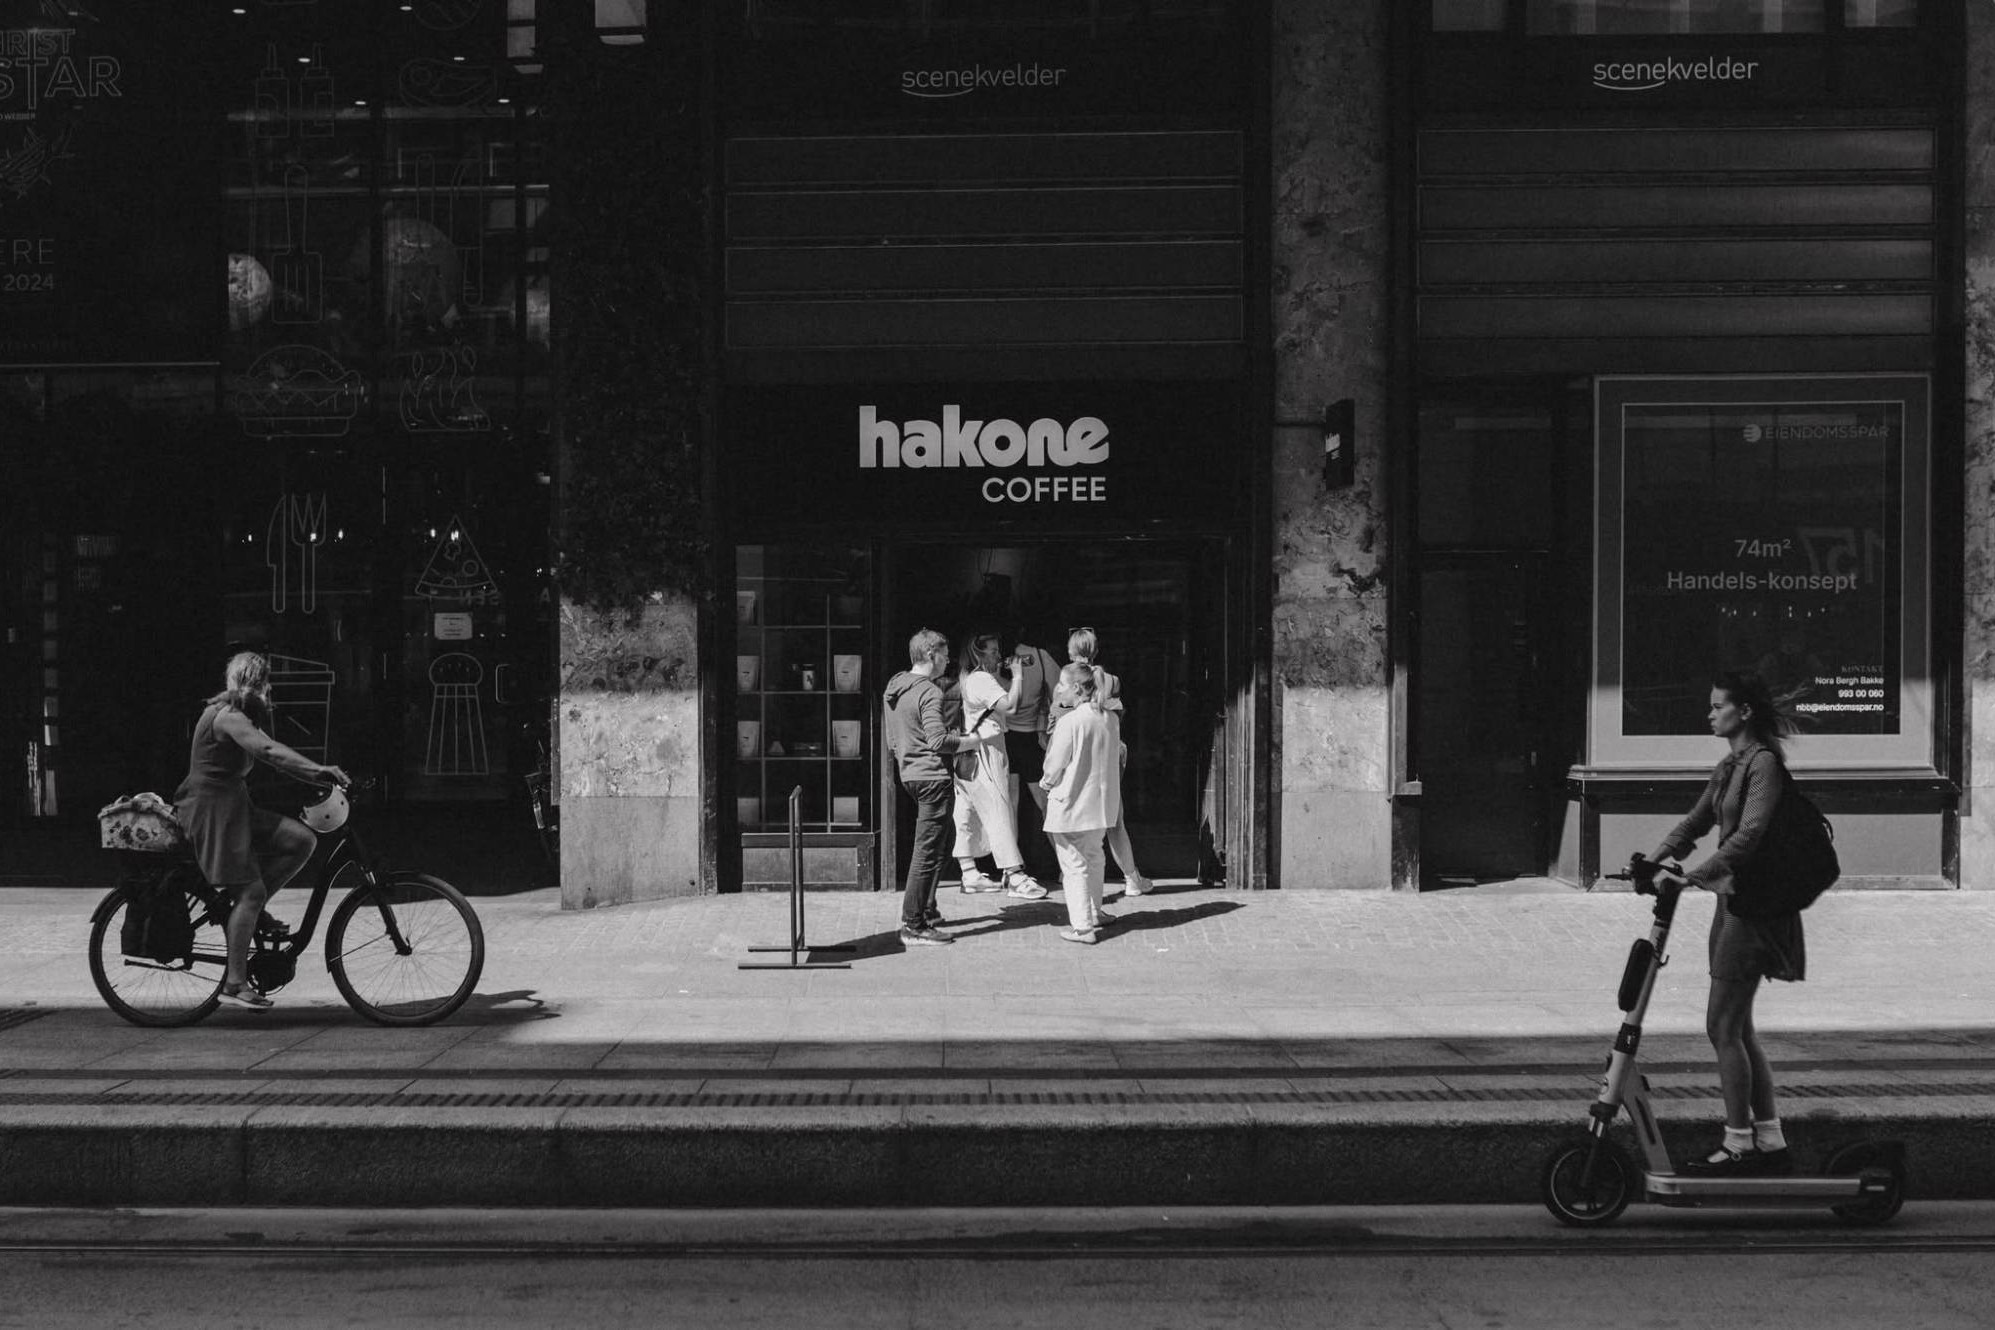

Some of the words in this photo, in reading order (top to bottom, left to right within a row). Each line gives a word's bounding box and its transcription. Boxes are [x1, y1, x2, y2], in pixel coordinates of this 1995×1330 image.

[901, 61, 1067, 88] scenekvelder
[1593, 55, 1759, 81] scenekvelder
[2, 272, 55, 292] 2024
[858, 404, 1110, 469] hakone
[1765, 425, 1890, 439] EIENDOMSSPAR
[981, 476, 1107, 503] COFFEE
[1733, 538, 1792, 558] 74m²
[1667, 571, 1858, 595] Handels-konsept
[1815, 676, 1835, 685] Nora
[1860, 676, 1884, 684] Bakke
[1855, 689, 1867, 698] 00
